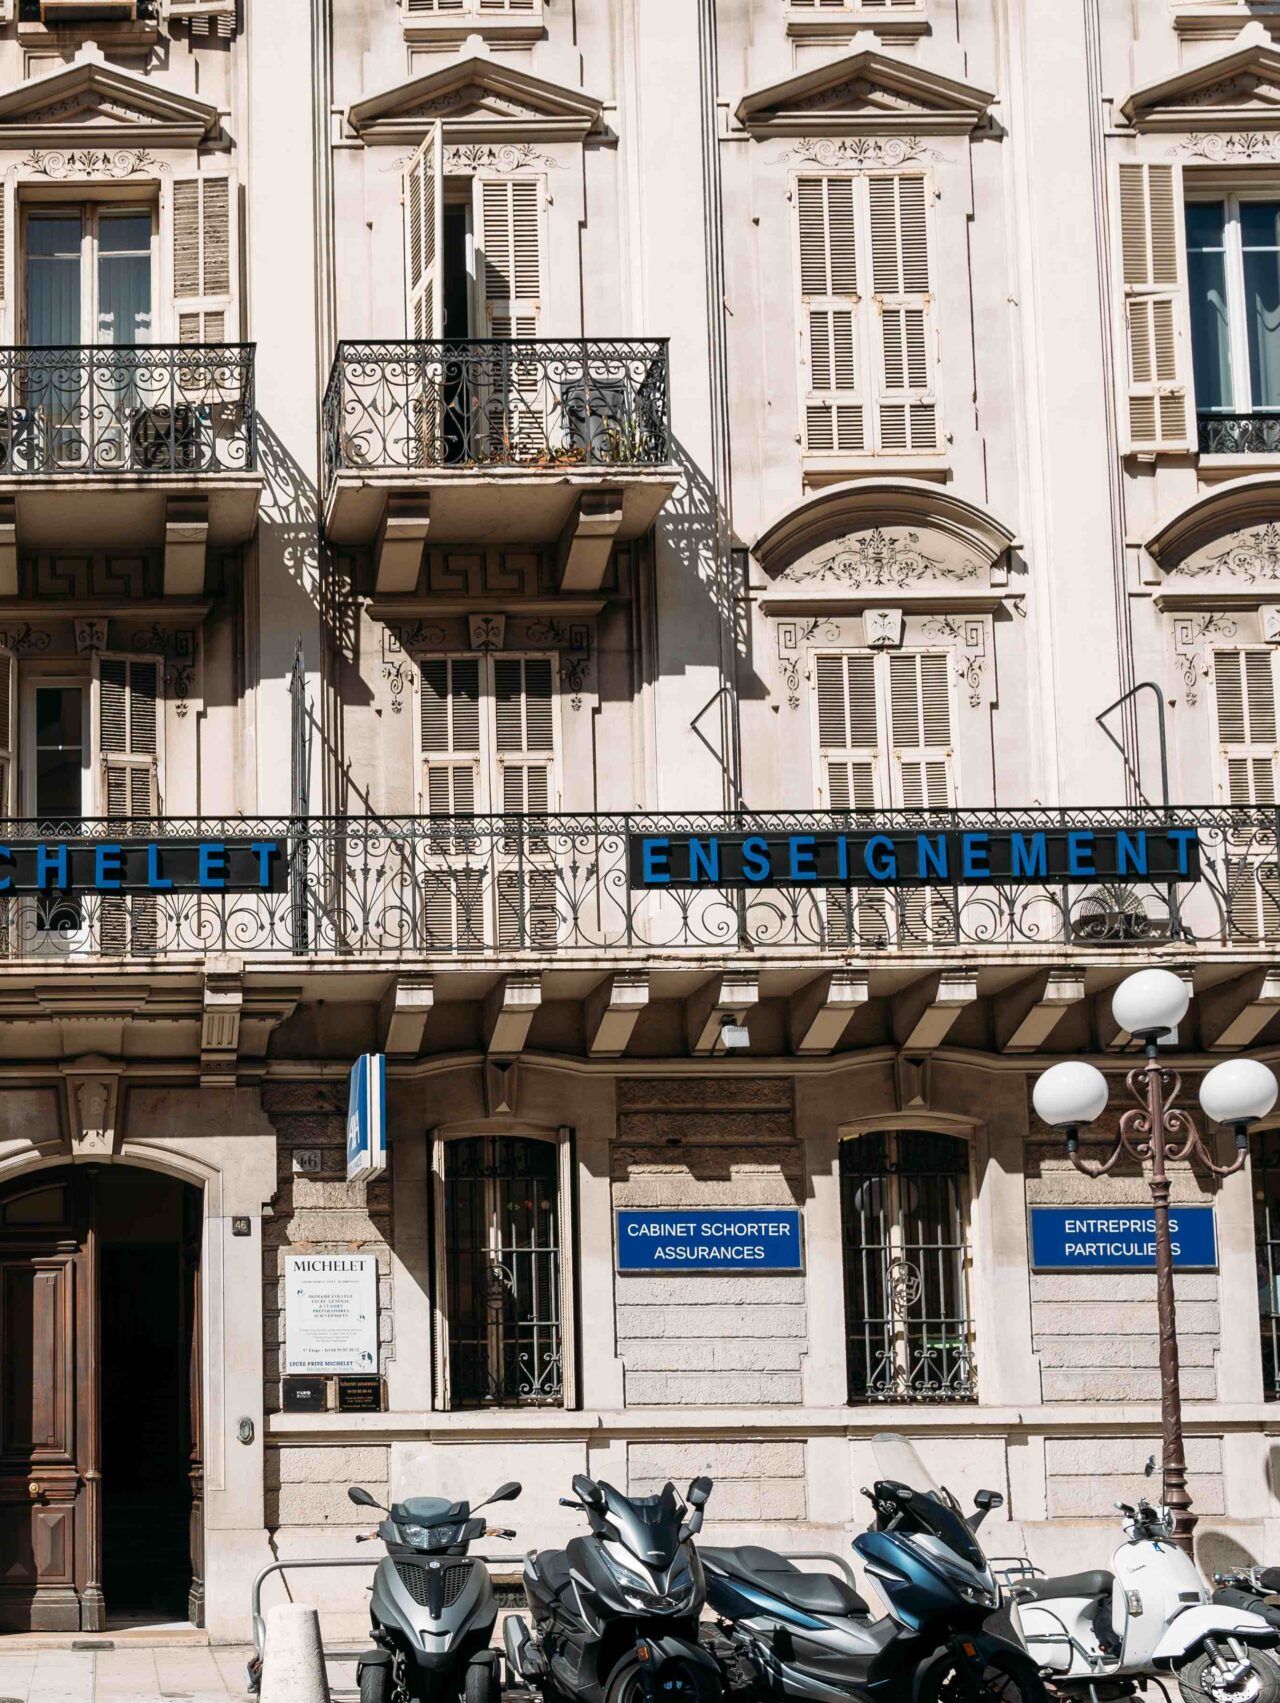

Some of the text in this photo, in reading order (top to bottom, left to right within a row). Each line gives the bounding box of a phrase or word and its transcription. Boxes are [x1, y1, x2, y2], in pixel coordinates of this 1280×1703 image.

[642, 830, 1197, 884] ENSEIGNEMENT
[235, 1220, 247, 1230] 46
[627, 1223, 790, 1237] CABINET SCHORTER
[1064, 1219, 1179, 1233] ENTREPRISS
[654, 1246, 765, 1260] ASSURANCES
[1065, 1242, 1181, 1256] PARTICULIES
[293, 1260, 367, 1272] MICHELET
